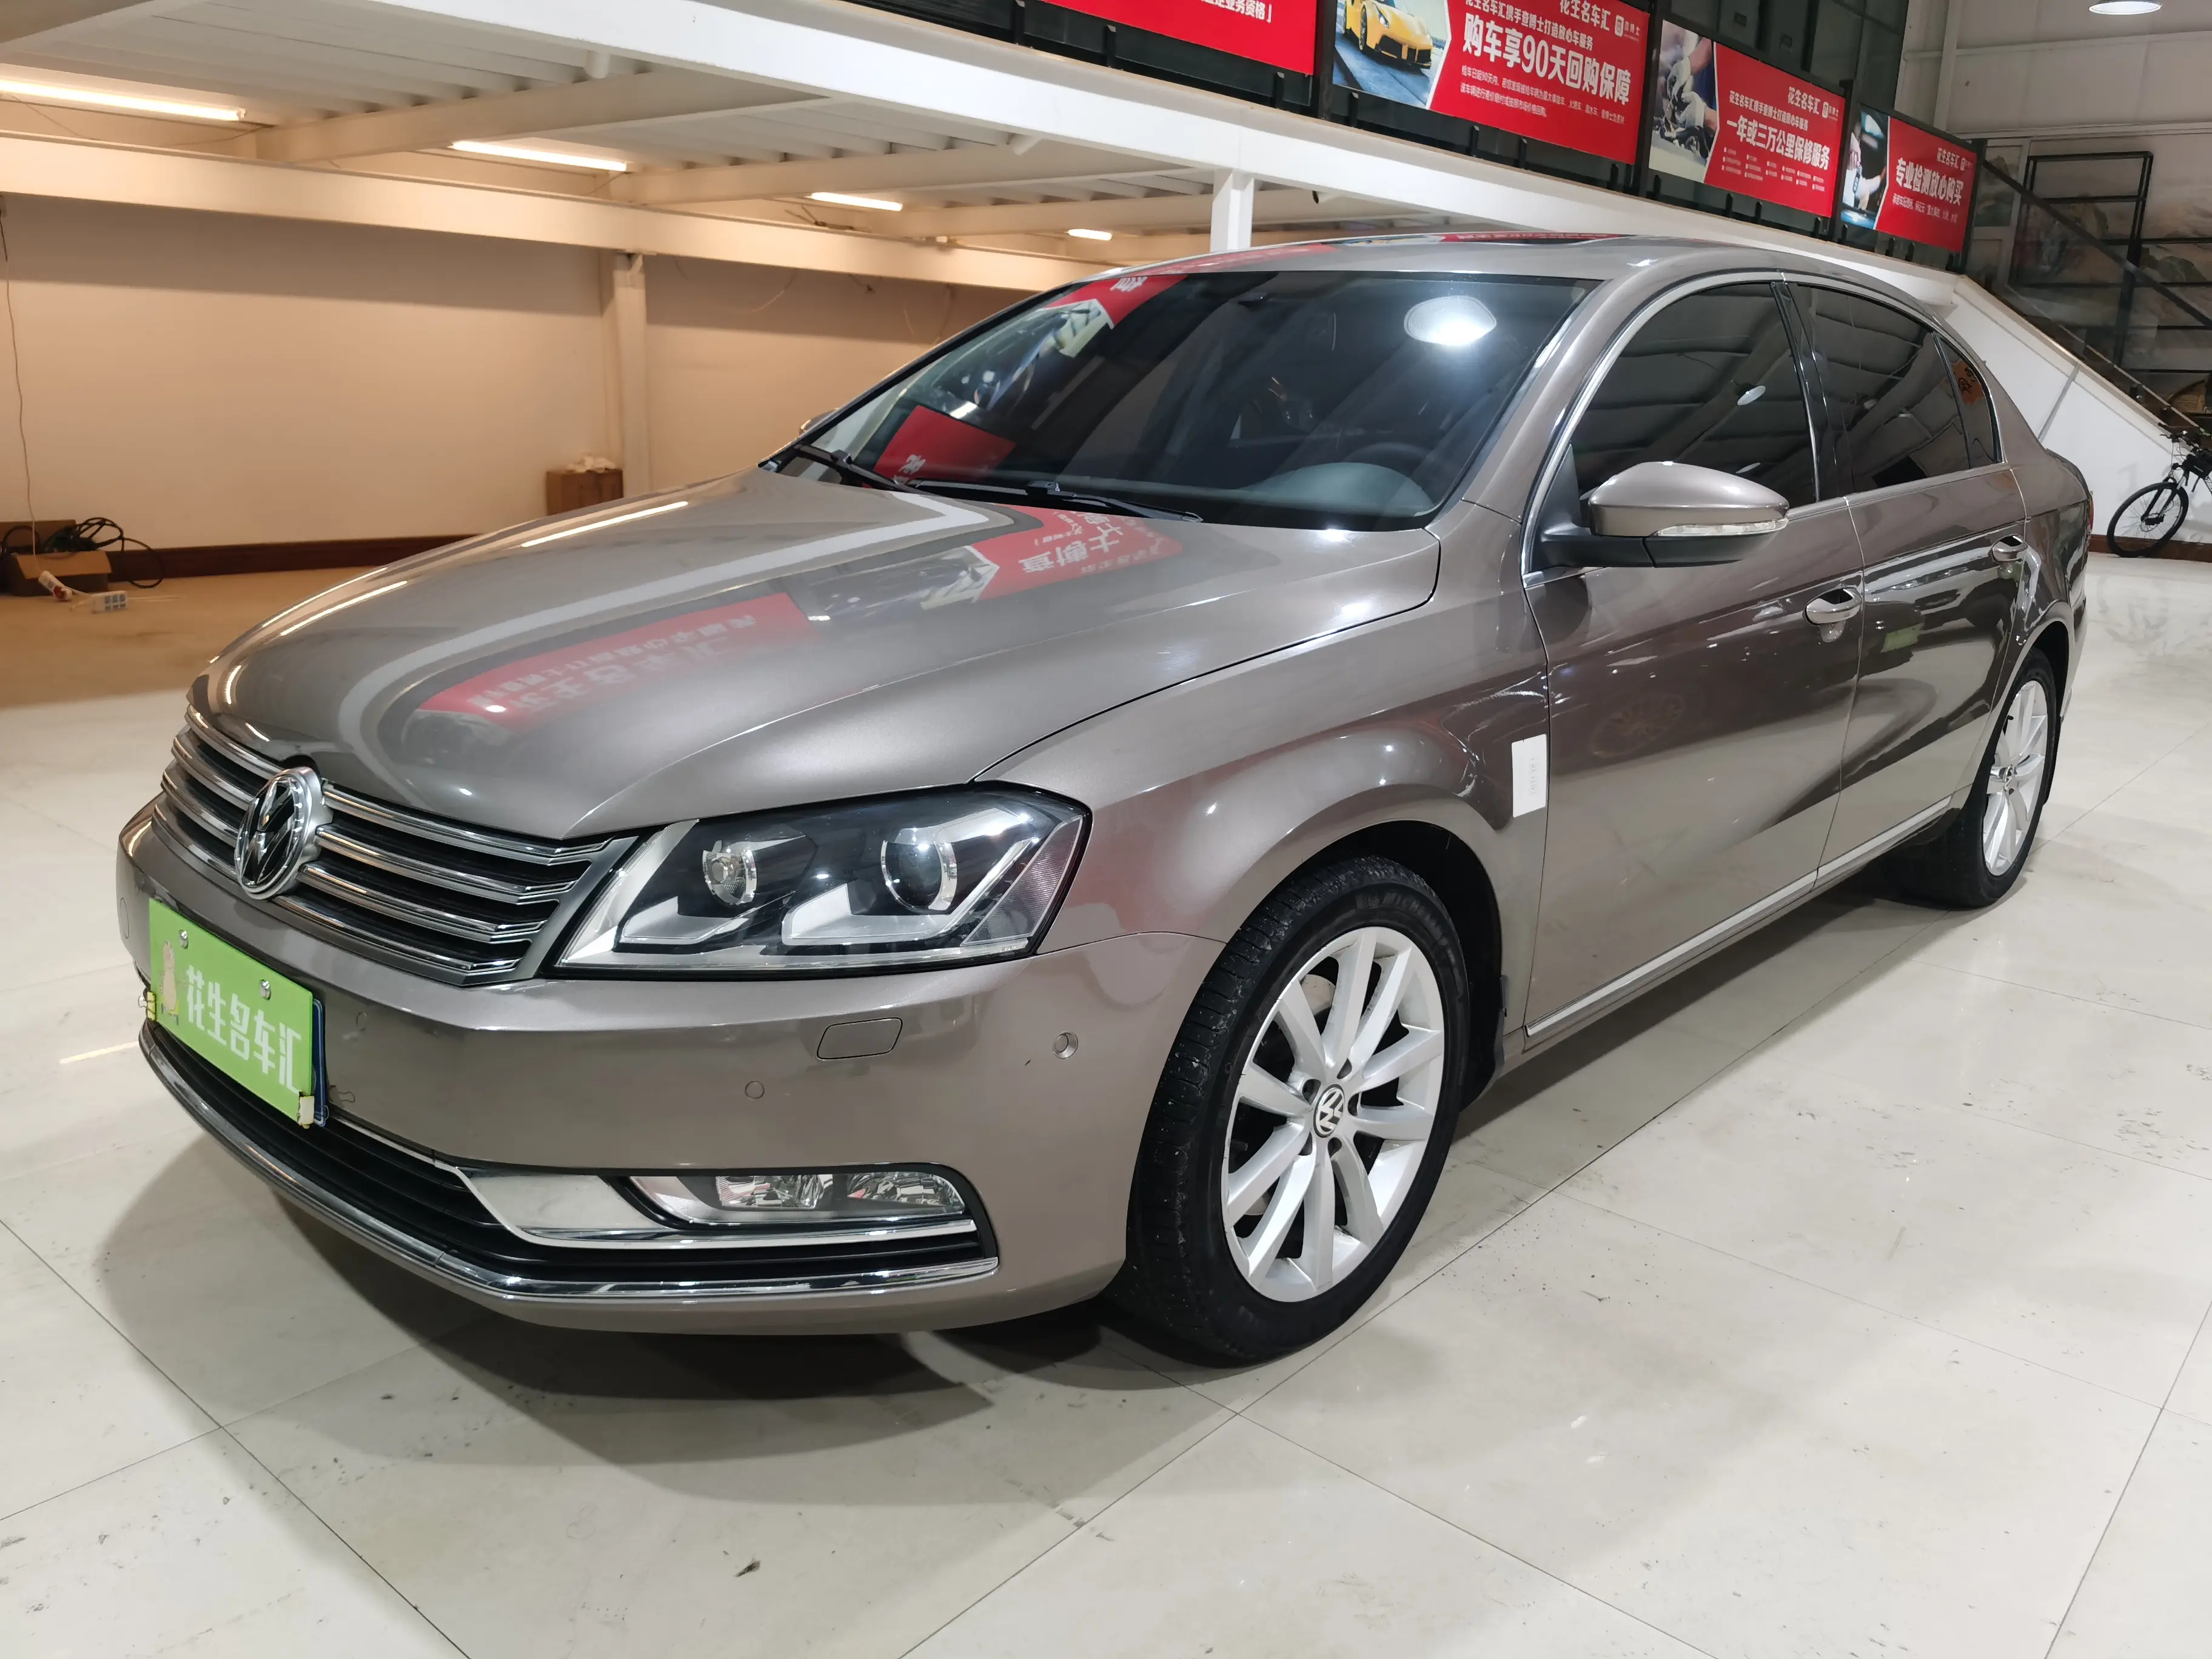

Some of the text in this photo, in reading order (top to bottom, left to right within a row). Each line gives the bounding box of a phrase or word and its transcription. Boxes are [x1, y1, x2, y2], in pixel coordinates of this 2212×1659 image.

[1463, 13, 1631, 105] 购车享90天回购保障
[1788, 86, 1820, 115] 花生名车汇
[1727, 115, 1830, 170] 一年或三万公里保修服务
[1896, 158, 1964, 206] 专业检测放心购买
[186, 965, 302, 1094] 花生名车汇
